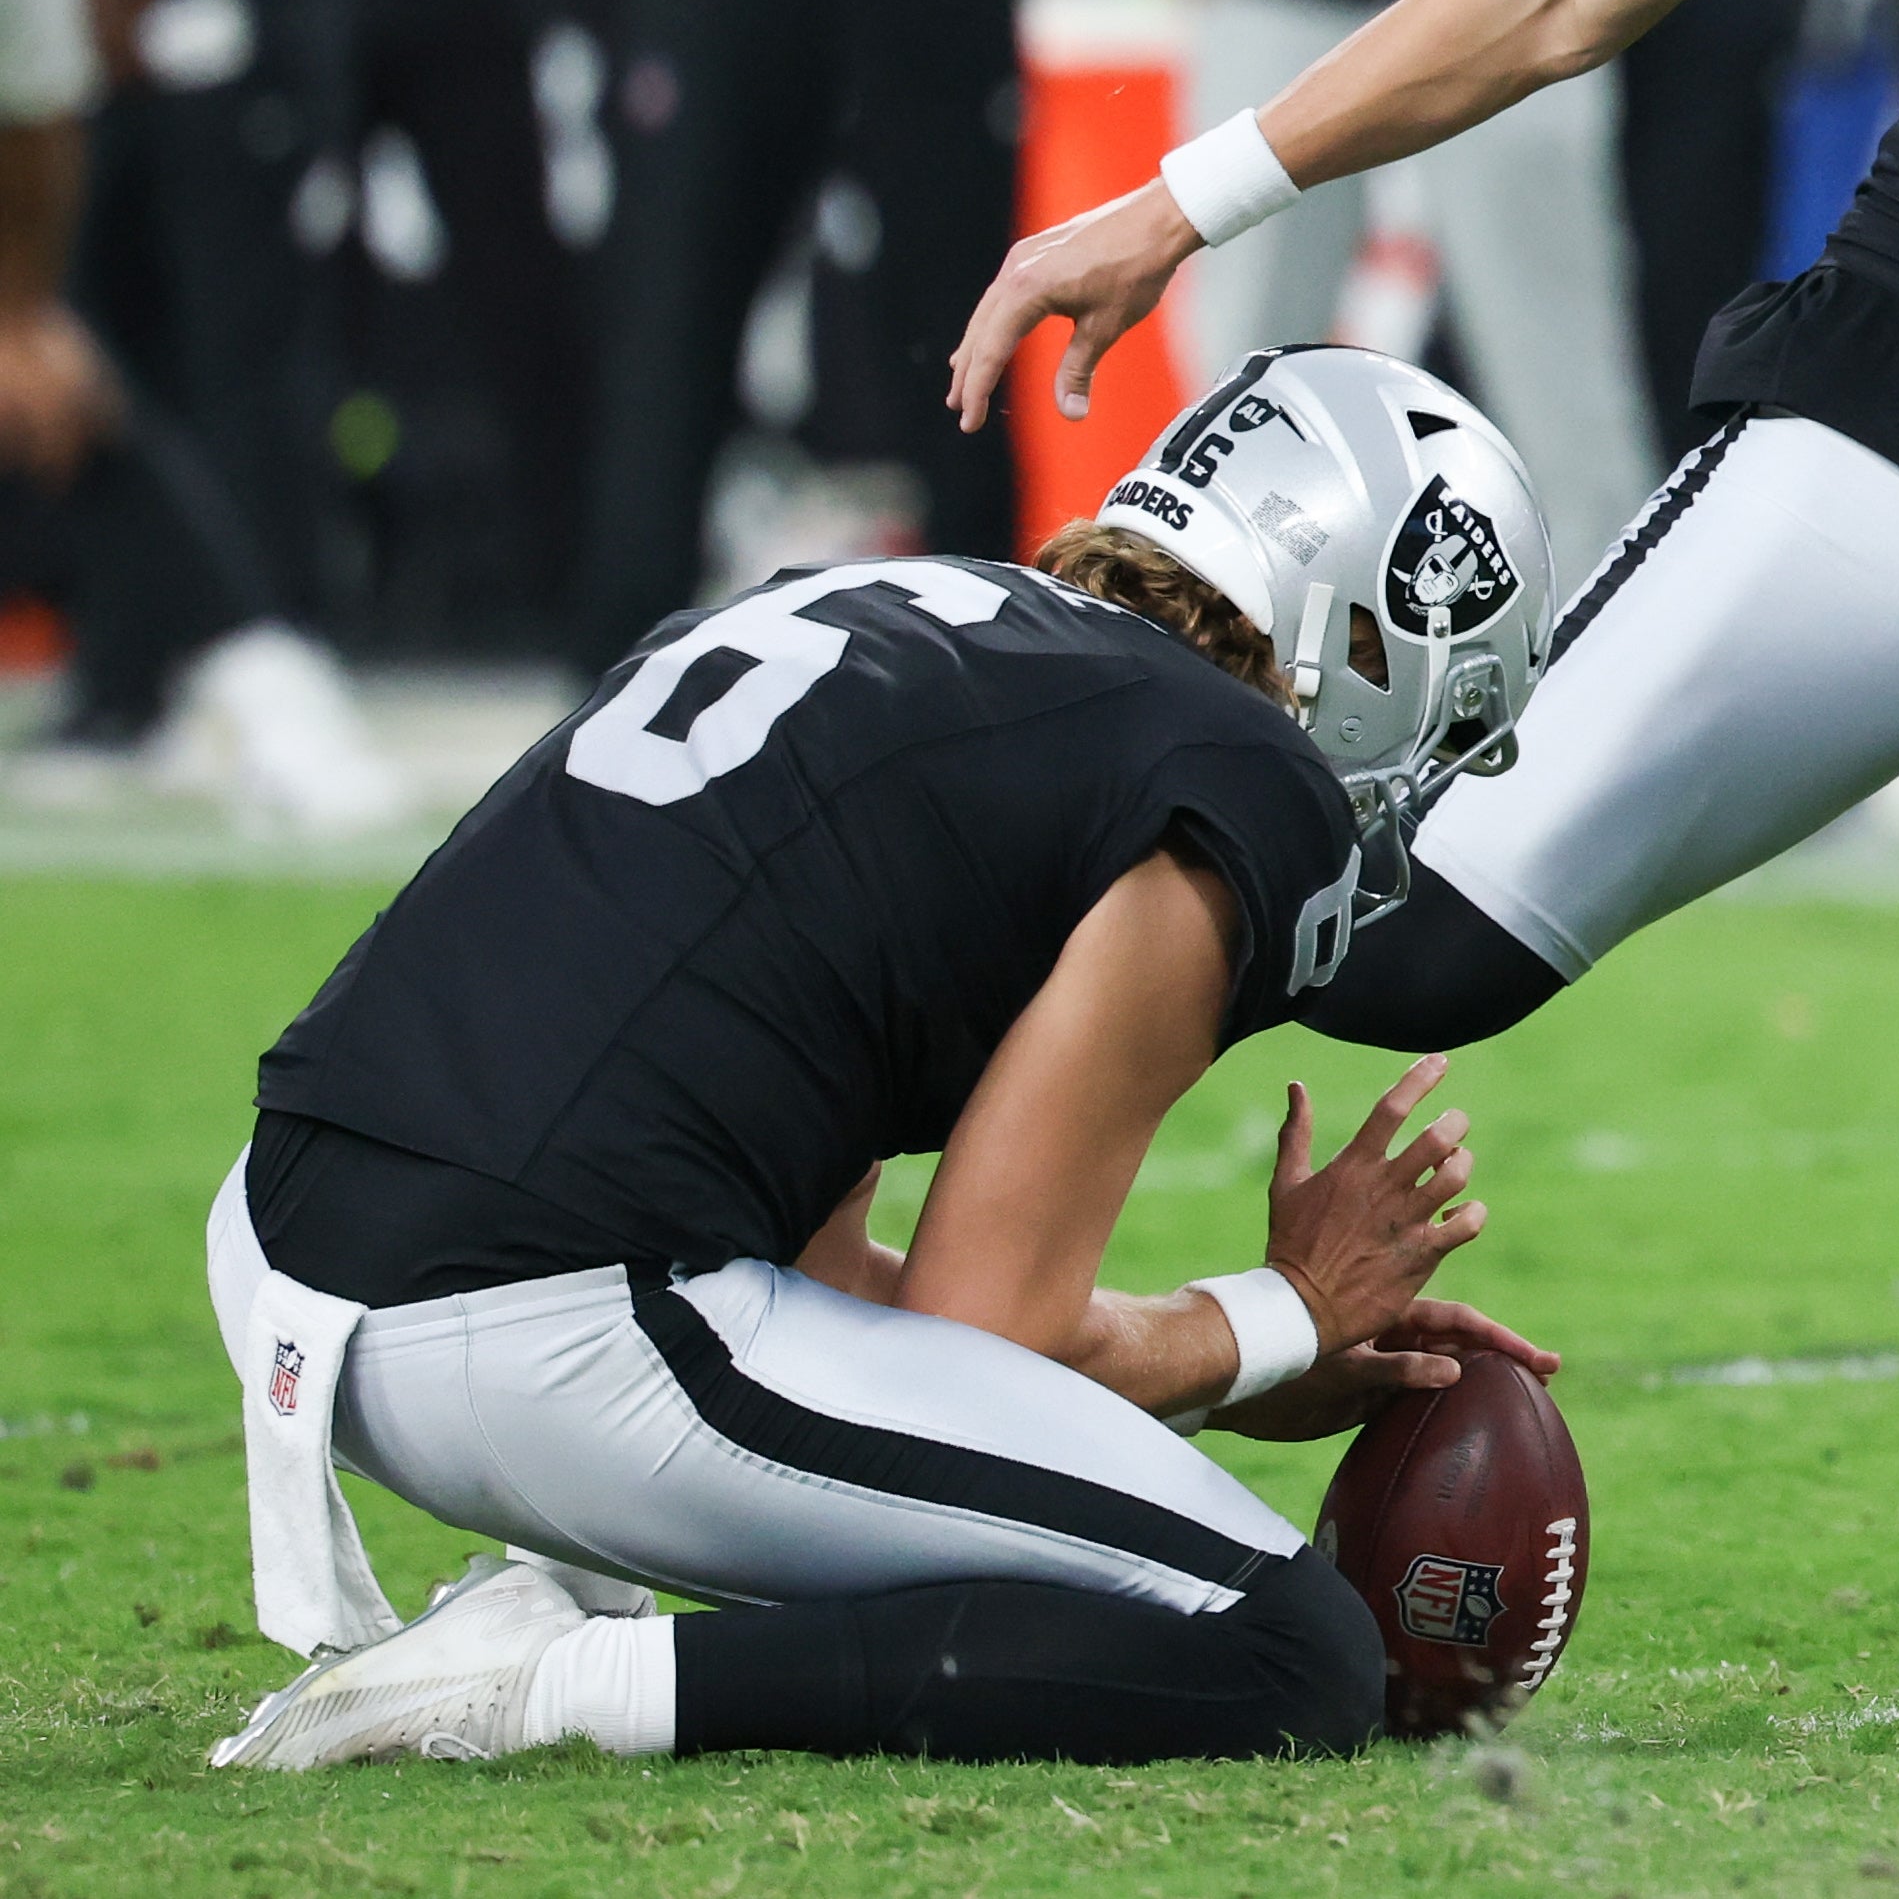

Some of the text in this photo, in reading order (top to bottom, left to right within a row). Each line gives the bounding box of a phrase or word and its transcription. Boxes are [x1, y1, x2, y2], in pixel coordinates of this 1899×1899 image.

[1236, 401, 1263, 426] AL
[1438, 487, 1511, 586] RAIDERS
[565, 561, 1012, 806] 6
[271, 1367, 297, 1410] NFL
[1405, 1563, 1465, 1631] NFL
